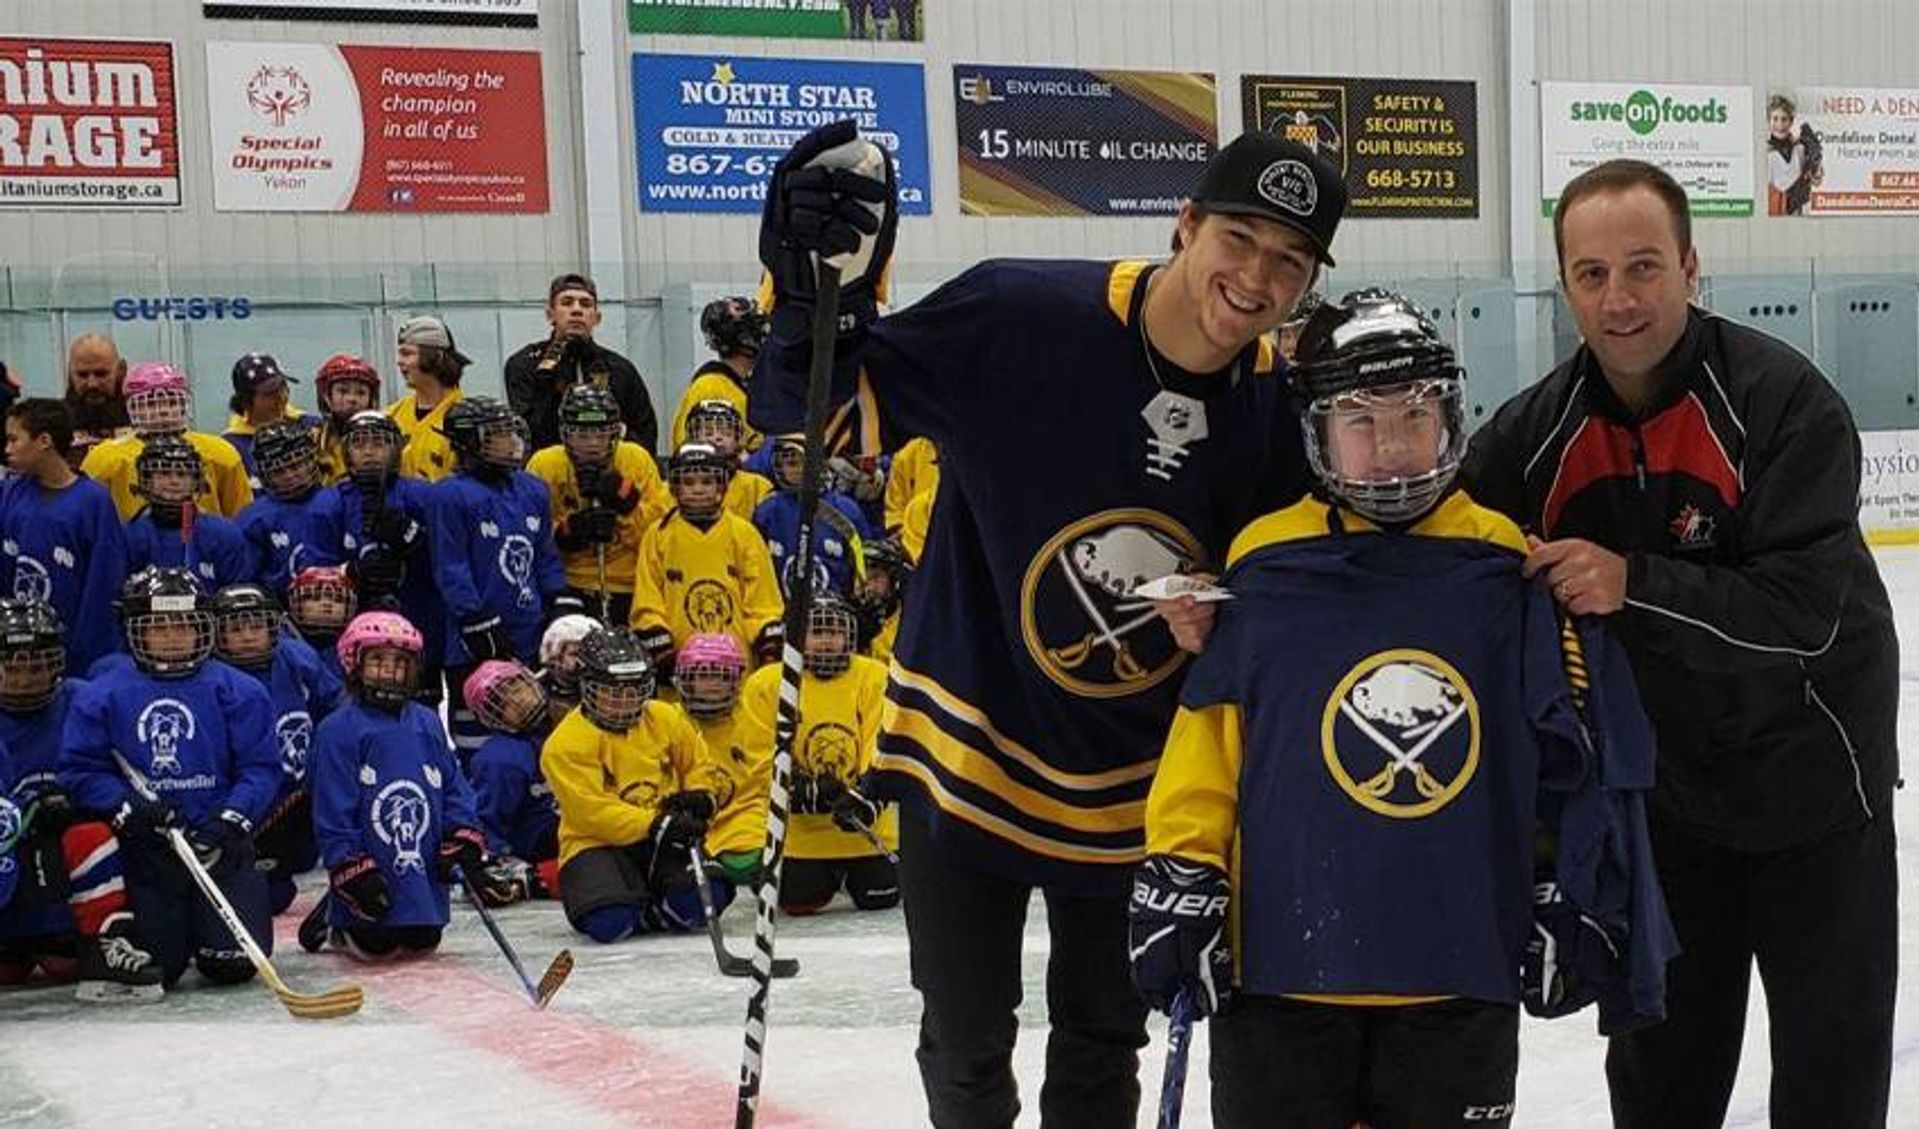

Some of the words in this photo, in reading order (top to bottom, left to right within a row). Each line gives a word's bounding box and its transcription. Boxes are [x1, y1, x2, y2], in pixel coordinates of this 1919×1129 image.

[382, 67, 469, 91] Revealing
[474, 70, 505, 89] the
[680, 81, 791, 107] NORTH
[798, 86, 877, 109] STAR
[1006, 80, 1113, 98] ENVIROLUBE
[382, 94, 477, 115] champion
[1374, 94, 1429, 113] SAFETY
[1433, 97, 1445, 112] &
[1824, 98, 1865, 114] NEED
[1872, 98, 1884, 114] A
[725, 109, 775, 126] MINI
[1365, 117, 1435, 134] SECURITY
[1439, 119, 1454, 134] IS
[384, 120, 401, 138] in
[404, 119, 428, 138] all
[433, 120, 454, 141] of
[456, 124, 479, 139] us
[671, 131, 720, 145] COLD
[724, 133, 738, 145] &
[241, 136, 323, 152] Special
[978, 129, 1010, 158] 15
[1014, 140, 1091, 160] MINUTE
[1131, 142, 1208, 162] CHANGE
[1356, 138, 1391, 156] OUR
[1394, 139, 1465, 157] BUSINESS
[232, 155, 333, 172] Olympics
[264, 175, 306, 189] Yukon
[1366, 168, 1456, 189] 668-5713
[112, 297, 252, 321] GUESTS
